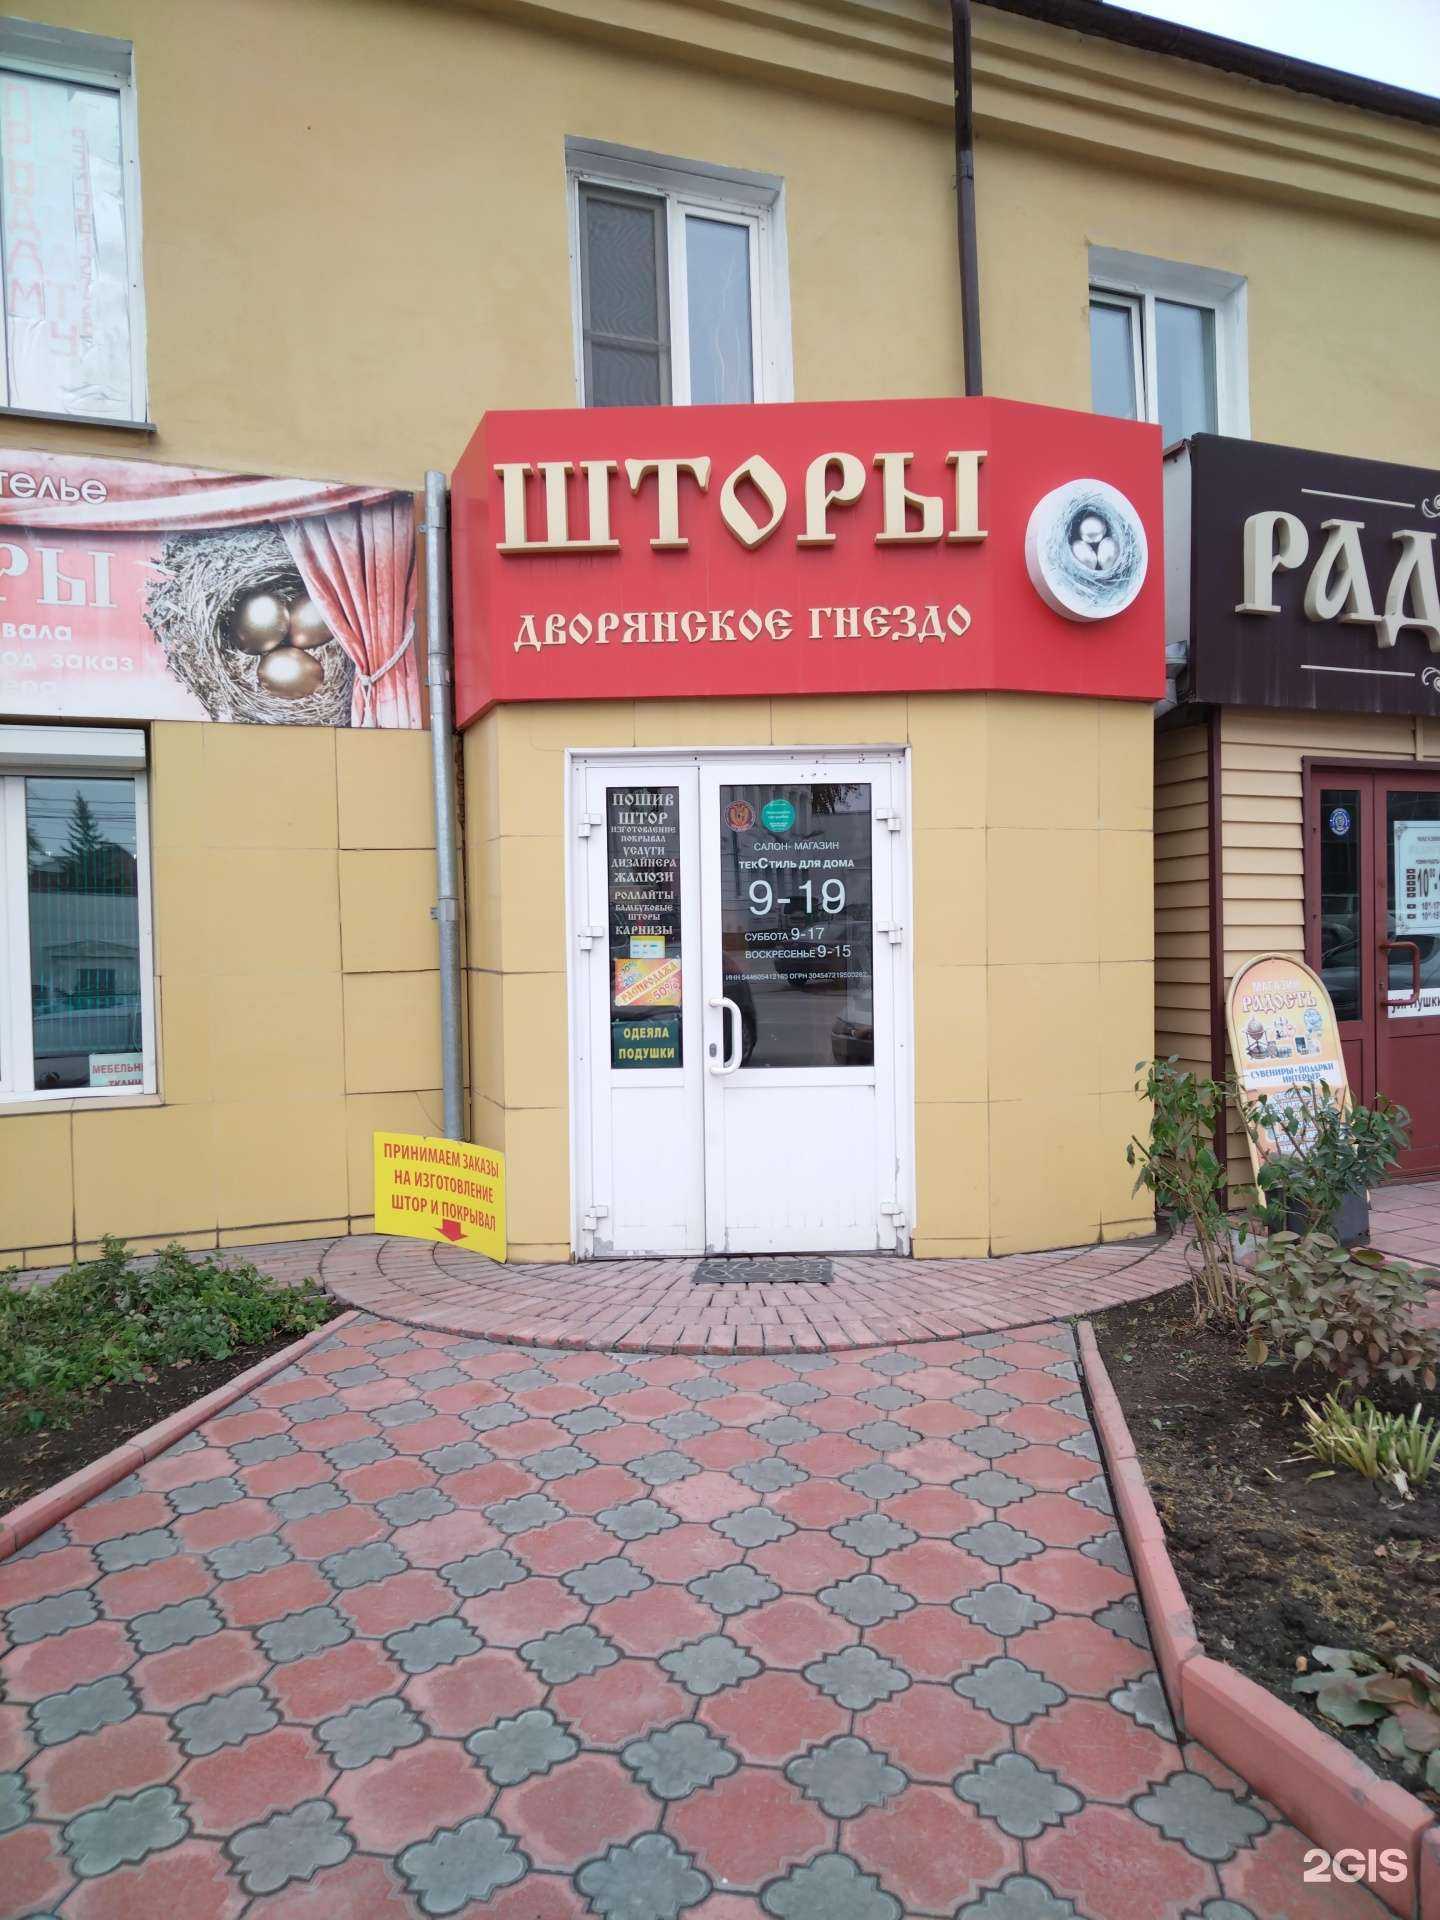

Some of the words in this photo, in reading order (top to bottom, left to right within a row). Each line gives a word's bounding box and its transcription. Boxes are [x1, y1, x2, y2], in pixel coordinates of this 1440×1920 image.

[494, 450, 989, 557] ШТОРЫ
[513, 608, 793, 653] ДВОРЯНСКОЕ
[808, 602, 973, 644] ГНЕЗДО
[50, 653, 135, 673] заказ
[612, 793, 675, 807] ПОШИВ
[617, 811, 669, 825] ШТОР
[621, 835, 666, 843] ПОКРЫВАЛ
[794, 841, 840, 850] МАГАЗИН
[623, 846, 666, 857] УСЛУГИ
[611, 857, 678, 868] ДИЗАЙНЕРА
[798, 859, 821, 869] ДЛЯ
[822, 859, 855, 869] ДОМА
[613, 872, 675, 883] ЖАЛЮЗИ
[614, 890, 674, 900] РОЛЛАЙТЫ
[615, 904, 674, 912] БАМБУКОВЫЕ
[628, 913, 661, 921] ШТОРЫ
[615, 925, 673, 935] КАРНИЗЫ
[744, 932, 789, 941] СУББОТА
[791, 927, 825, 940] 9-17
[745, 950, 816, 959] ВОСКРЕСЕНЬЕ
[817, 944, 852, 958] 9-15
[789, 972, 808, 980] ОГРН
[1242, 990, 1318, 1014] РАДОСТЬ
[623, 1026, 670, 1041] ОДЕЯЛА
[618, 1047, 676, 1061] ПОДУШКИ
[1250, 1066, 1296, 1080] СУВЕНИРЫ
[1297, 1062, 1335, 1074] ПОДАРКИ
[1282, 1072, 1322, 1084] ИНТЕРЬЕР
[383, 1142, 461, 1168] ПРИНИМАЕМ
[463, 1153, 499, 1179] ЗАКАЗЫ
[394, 1169, 411, 1186] НА
[414, 1171, 494, 1204] ИЗГОТОВЛЕНИЕ
[391, 1194, 428, 1213] ШТОР
[431, 1200, 439, 1216] И
[442, 1202, 496, 1232] ПОКРЫВАЛ
